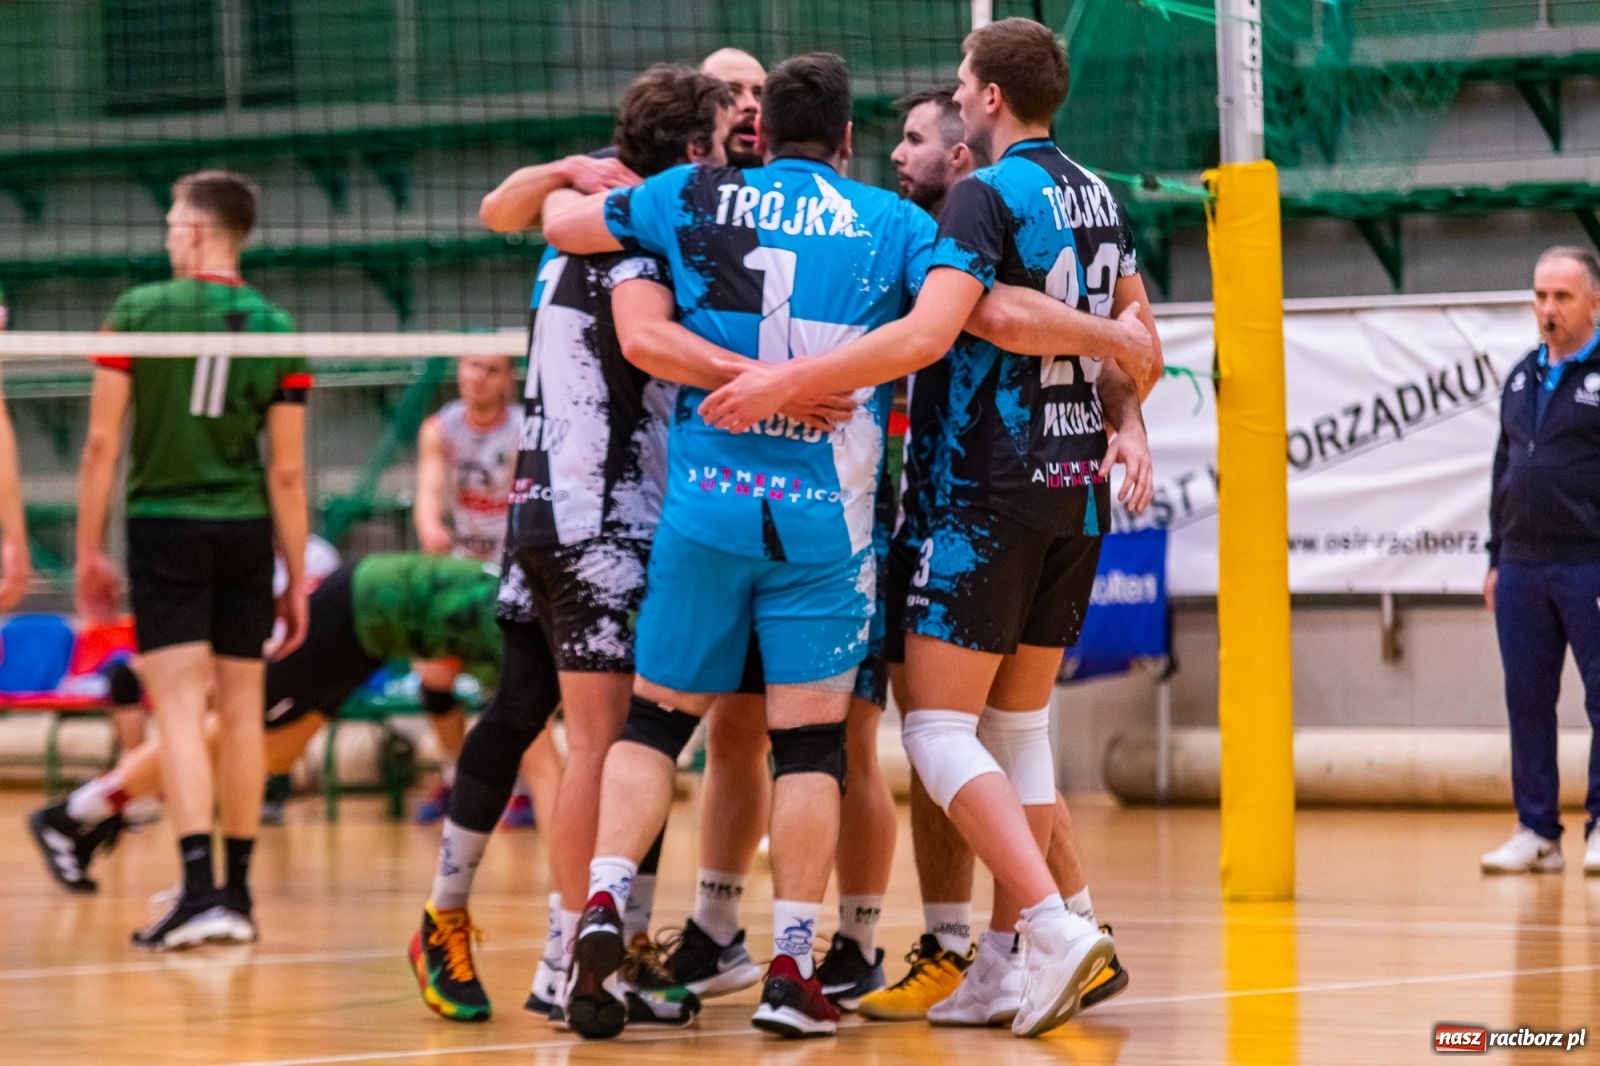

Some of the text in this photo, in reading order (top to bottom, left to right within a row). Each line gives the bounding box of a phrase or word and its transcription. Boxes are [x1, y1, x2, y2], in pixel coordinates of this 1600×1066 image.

[715, 181, 857, 238] TRÓJKA
[1042, 174, 1120, 231] TRÓJKA
[743, 246, 798, 366] 1
[1287, 352, 1501, 473] ORZĄDKU!
[912, 537, 934, 588] 3
[1090, 569, 1158, 606] olten
